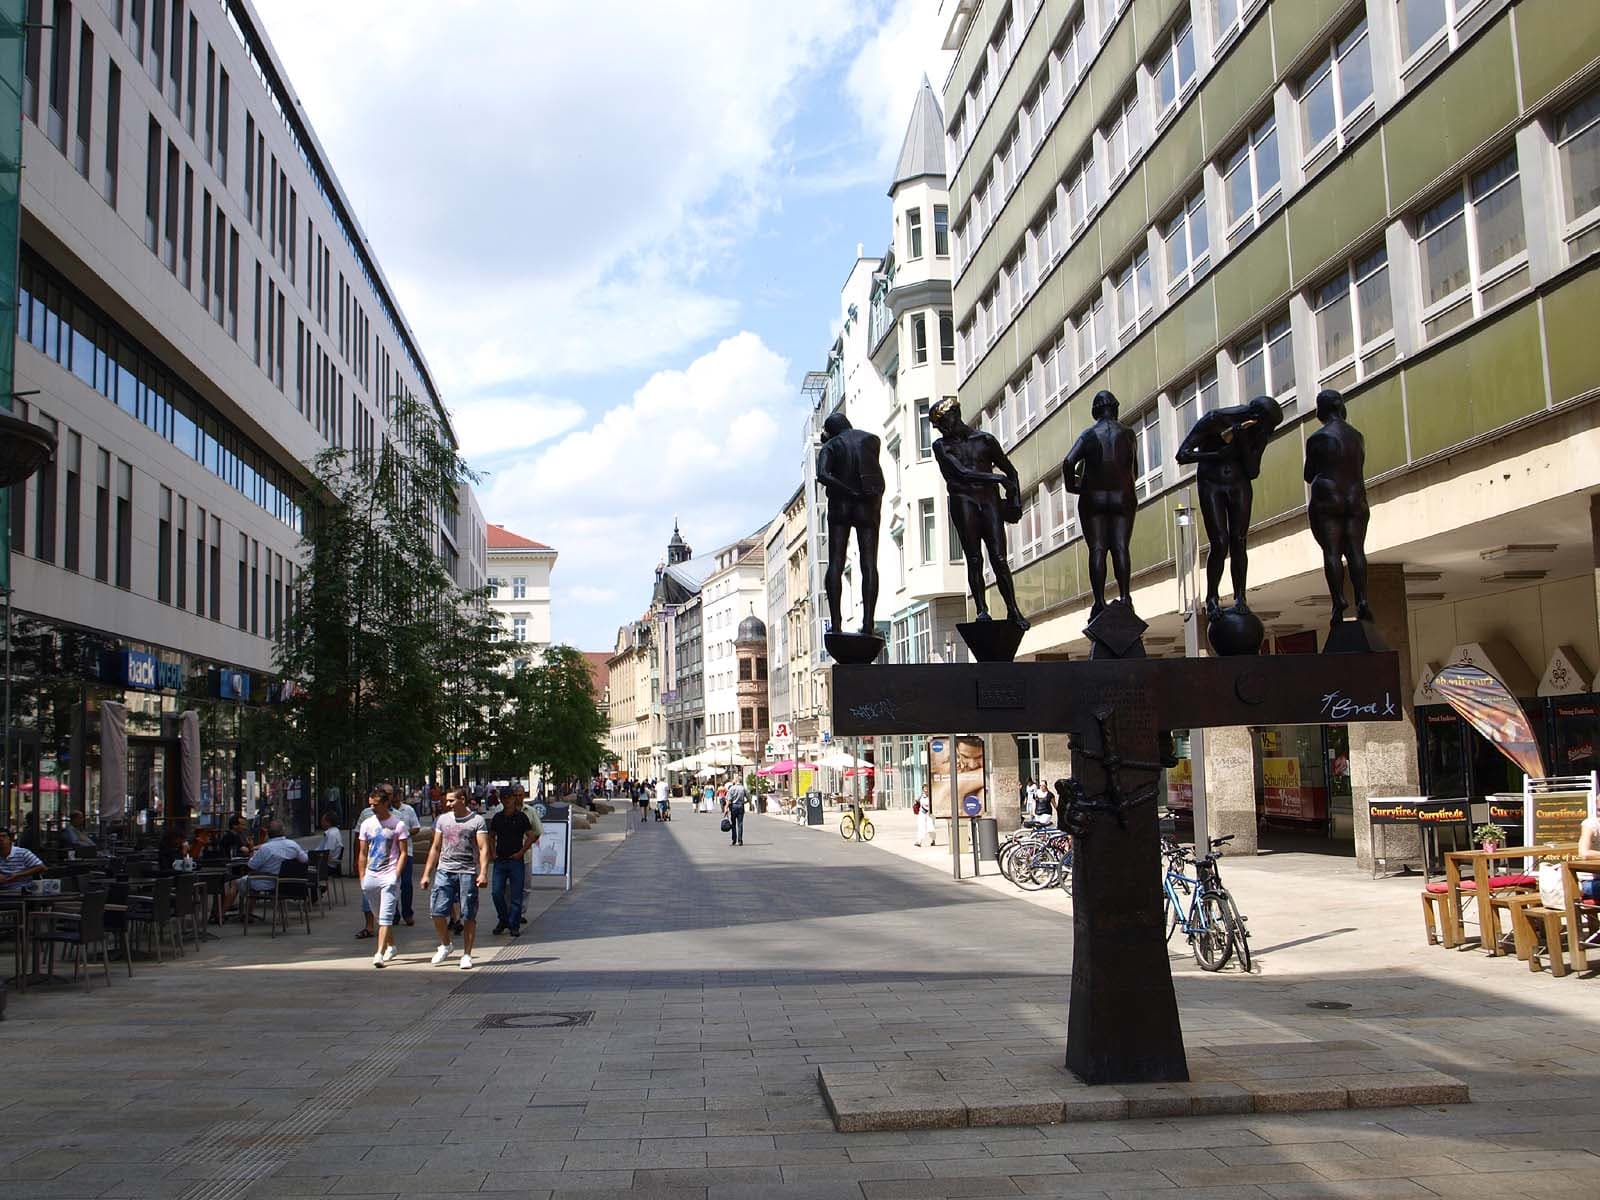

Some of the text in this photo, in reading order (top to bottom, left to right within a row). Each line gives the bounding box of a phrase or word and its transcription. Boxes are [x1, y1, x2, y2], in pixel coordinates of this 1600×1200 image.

[128, 652, 155, 685] back
[776, 723, 789, 737] A
[1419, 808, 1464, 822] Curryfire.de
